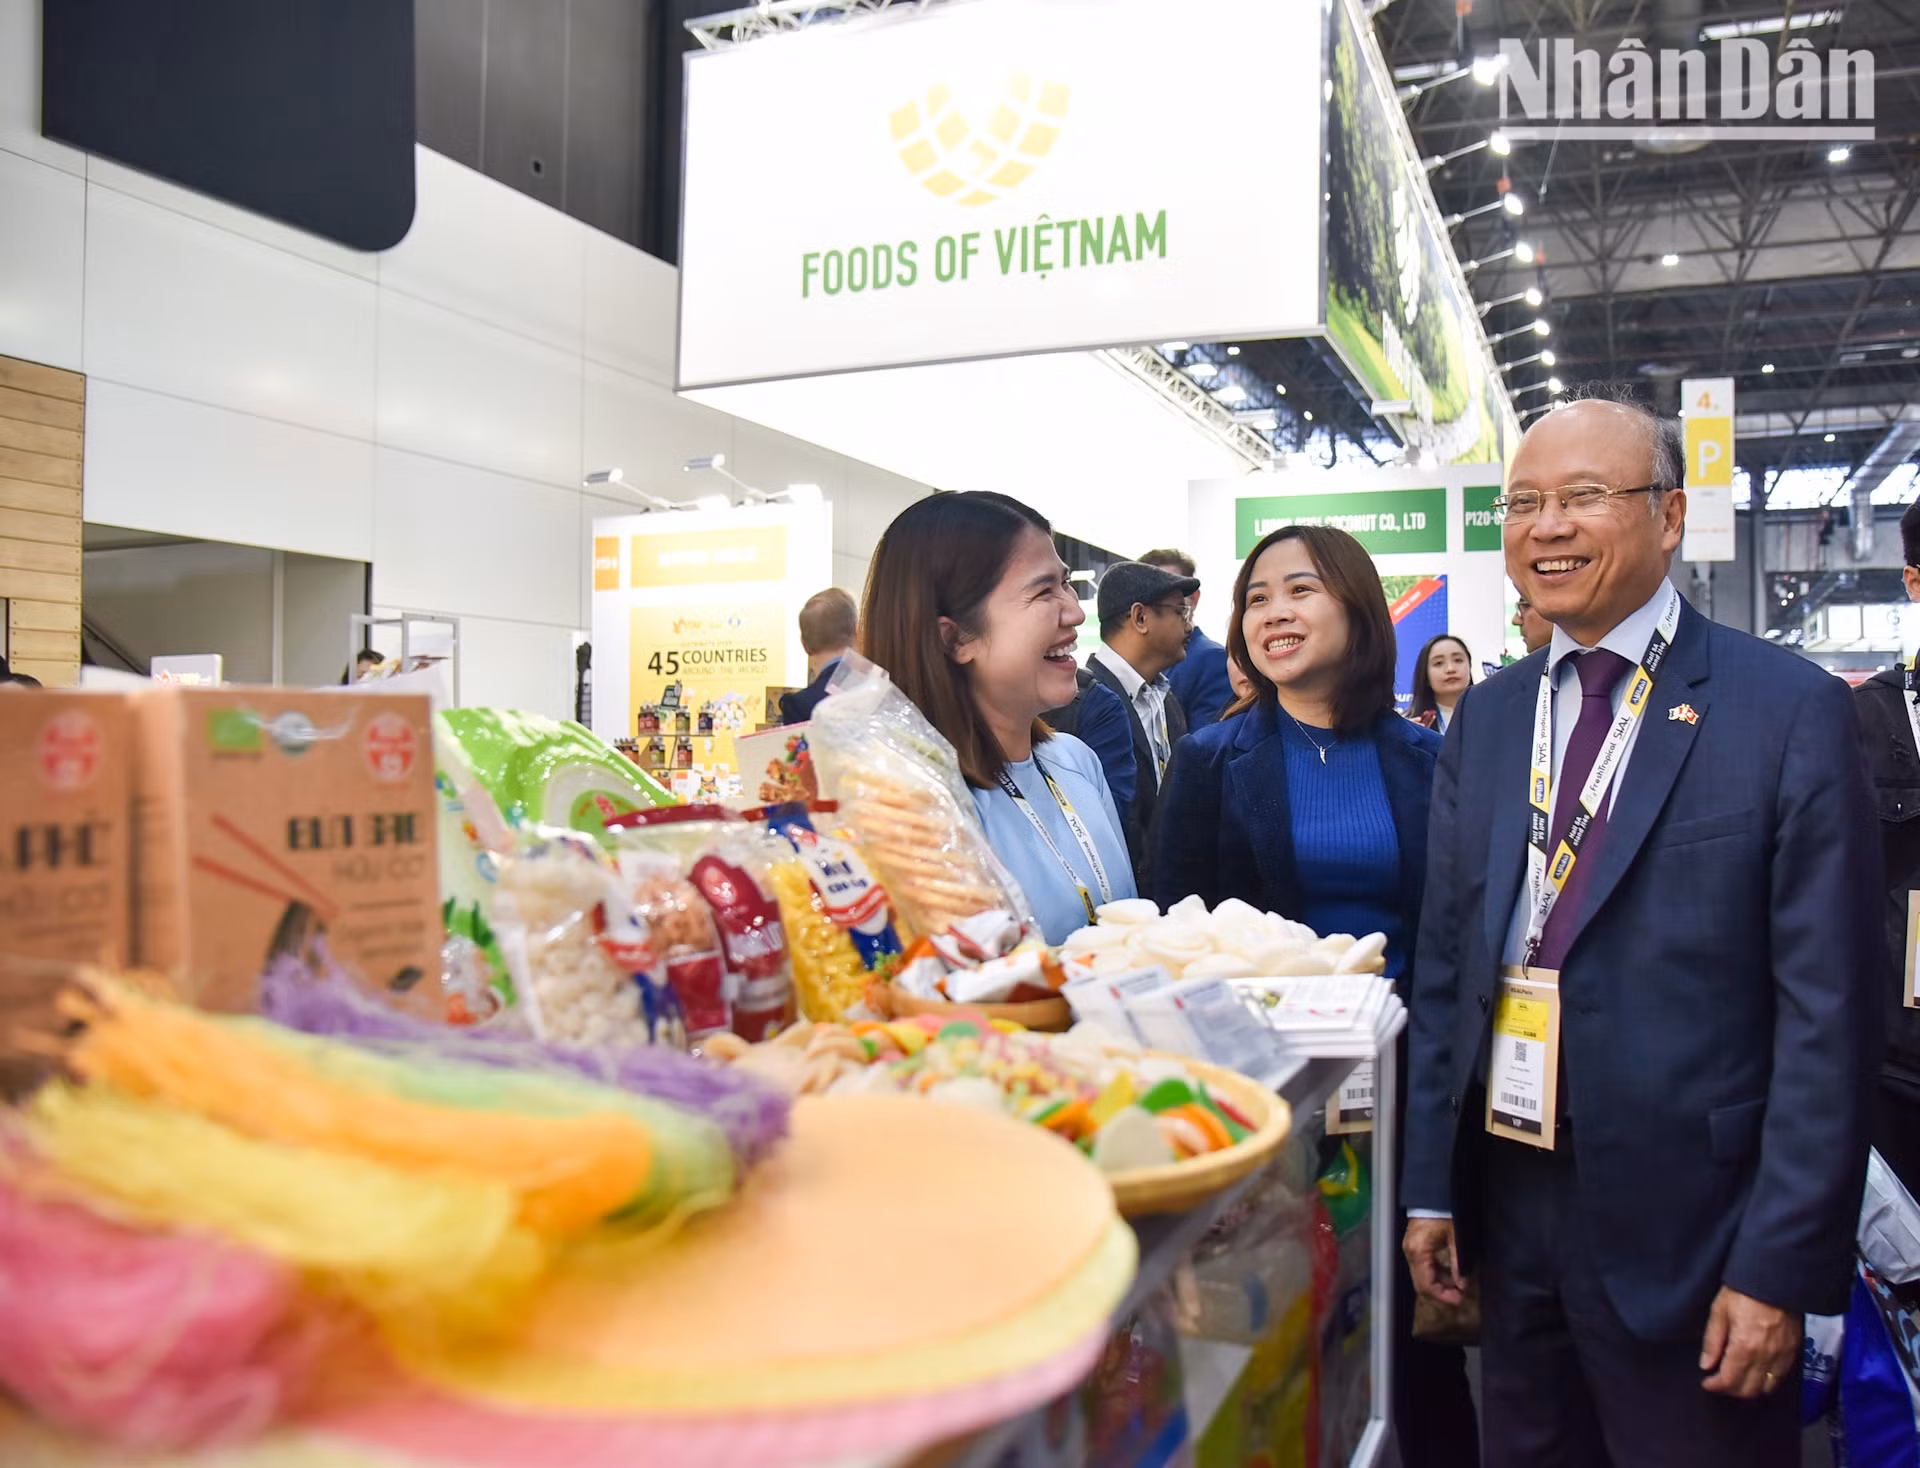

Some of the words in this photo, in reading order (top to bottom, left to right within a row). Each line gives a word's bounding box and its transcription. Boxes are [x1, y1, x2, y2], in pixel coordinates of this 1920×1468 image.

[801, 240, 918, 299] FOODS
[935, 231, 981, 282] OF
[994, 209, 1168, 281] VIỆTNAM
[1698, 440, 1722, 479] P
[1403, 511, 1426, 530] LTD
[647, 651, 680, 676] 45
[682, 648, 767, 664] COUNTRIES
[1537, 742, 1547, 766] SIAL
[1589, 742, 1617, 792] FreshTropical
[1613, 716, 1632, 741] SIAL
[1539, 891, 1555, 916] SIAL
[1512, 1118, 1522, 1128] VIP
